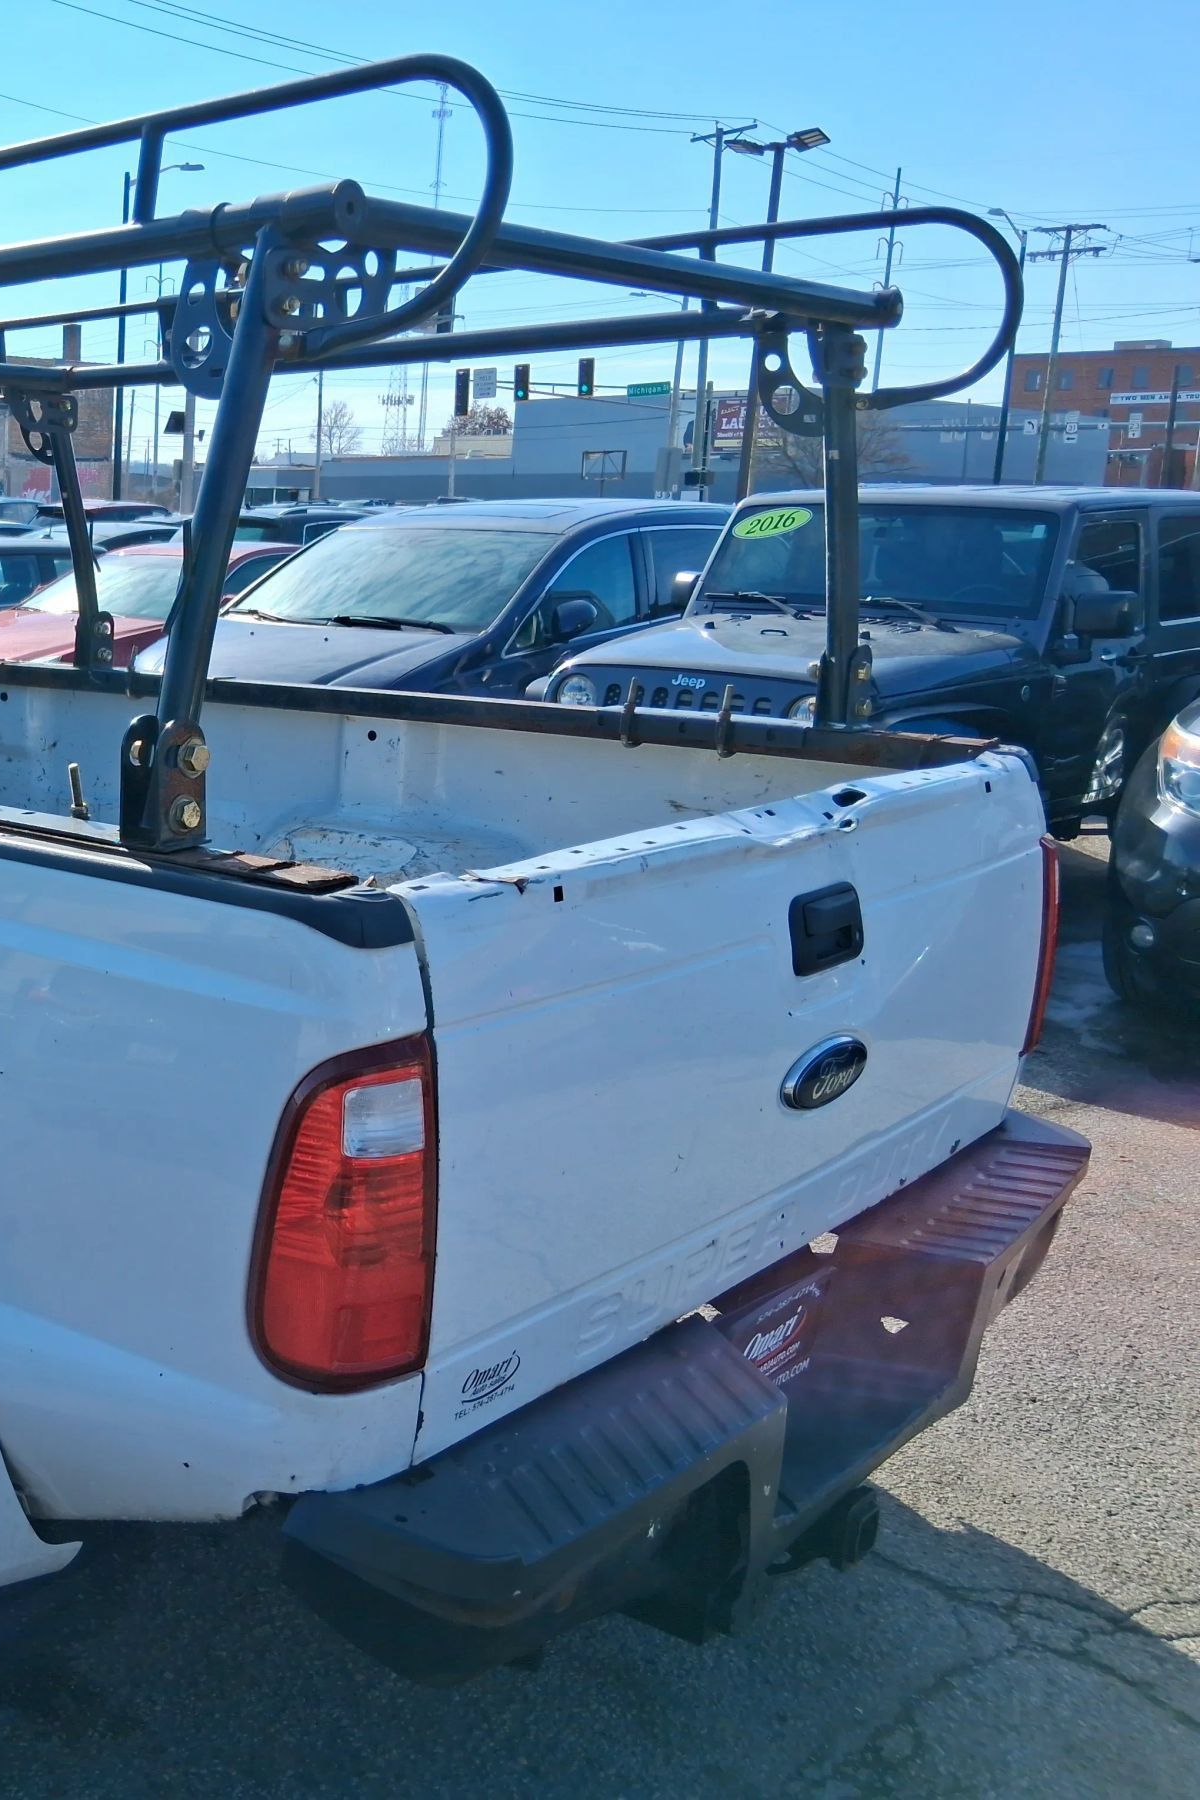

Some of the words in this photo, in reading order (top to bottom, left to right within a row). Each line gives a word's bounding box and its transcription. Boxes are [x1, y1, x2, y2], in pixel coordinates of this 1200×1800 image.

[628, 386, 662, 395] Michigan
[745, 510, 801, 536] 2016
[671, 673, 706, 690] Jeep
[811, 1046, 859, 1100] Ford
[574, 1200, 797, 1360] SUPER
[743, 1305, 803, 1360] Omari
[461, 1349, 517, 1394] Omari
